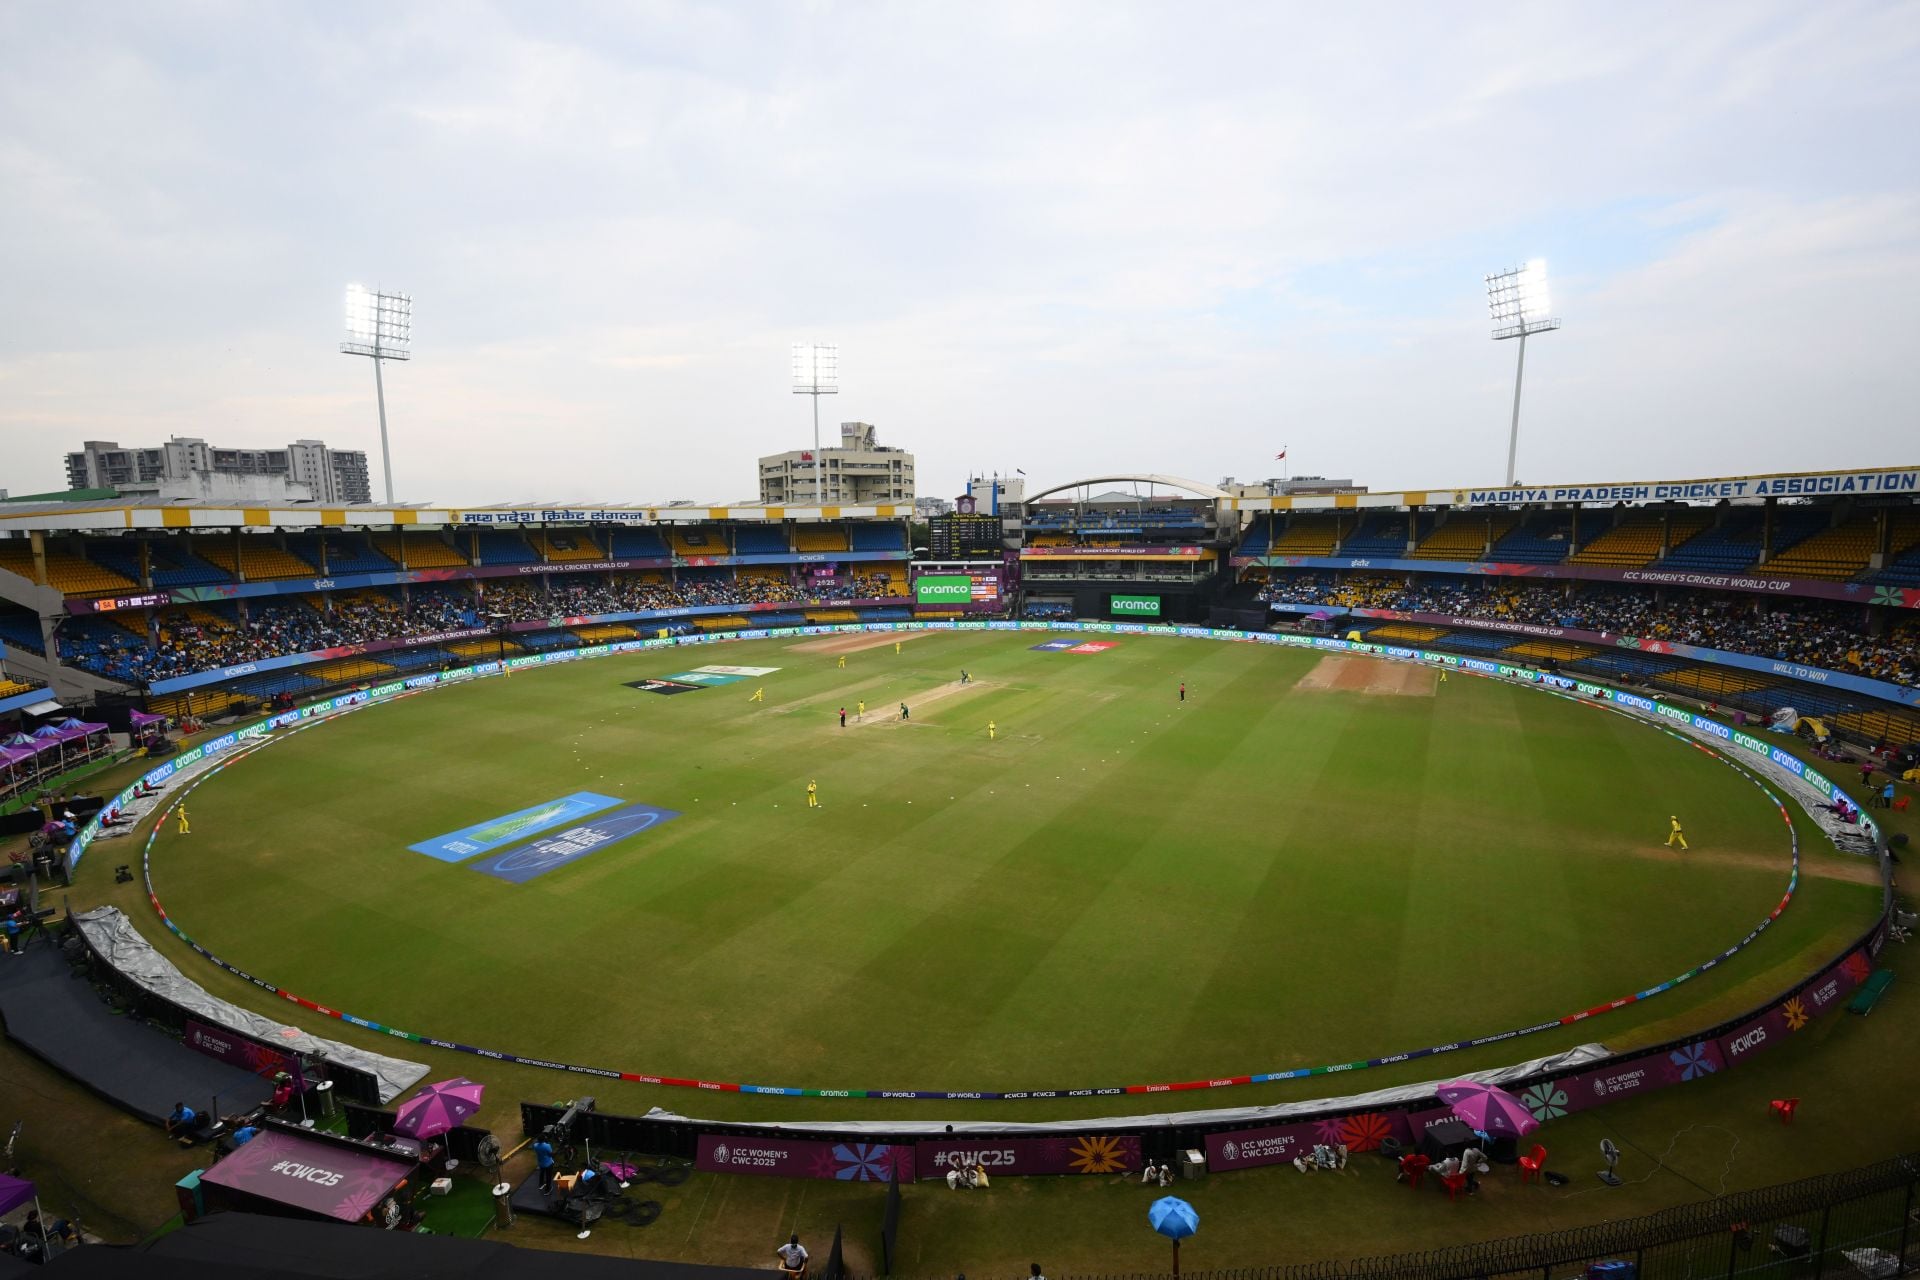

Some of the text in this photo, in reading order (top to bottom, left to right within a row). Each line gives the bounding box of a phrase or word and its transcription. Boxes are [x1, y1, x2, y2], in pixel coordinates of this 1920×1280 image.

[1471, 473, 1917, 503] MADHYA PRADESH CRICKET ASSOCIATION
[464, 510, 643, 523] मध्य प्रदेश क्रिकेट संगठन
[564, 563, 592, 571] CRICKET
[1623, 571, 1791, 591] ICC WOMEN'S CRICKET WORLD CUP
[920, 585, 968, 594] aramco
[1112, 599, 1158, 610] aramco
[927, 621, 955, 629] aramco
[958, 621, 985, 629] aramco
[989, 621, 1017, 629] aramco
[1020, 621, 1048, 629] aramco
[1051, 622, 1079, 630] aramco
[1083, 623, 1112, 631] aramco
[1115, 624, 1143, 632] aramco
[1147, 625, 1176, 634] aramco
[1465, 619, 1495, 628] WOMEN'S
[1495, 622, 1523, 632] CRICKET
[1523, 625, 1548, 635] WORLD
[1549, 628, 1564, 636] CUP
[1180, 627, 1209, 636] aramco
[1213, 629, 1243, 638] aramco
[405, 637, 416, 645] ICC
[417, 633, 447, 643] WOMEN'S
[446, 630, 470, 640] CRICKET
[644, 637, 673, 647] aramco
[1281, 635, 1312, 644] aramco
[1316, 638, 1346, 648] aramco
[579, 645, 608, 656] aramco
[612, 641, 640, 651] aramco
[511, 655, 541, 667] aramco
[545, 650, 575, 661] aramco
[442, 666, 472, 680] aramco
[1773, 663, 1829, 682] WILL TO WIN
[372, 682, 402, 697] aramco
[1617, 693, 1652, 710] aramco
[1657, 705, 1690, 723] aramco
[238, 722, 265, 740] aramco
[1695, 718, 1729, 738] aramco
[205, 735, 234, 754] aramco
[1734, 733, 1768, 755] aramco
[176, 748, 201, 769] aramco
[1773, 749, 1802, 774] aramco
[1804, 768, 1831, 794] aramco
[1730, 1026, 1767, 1056] #CWC25
[1389, 1054, 1409, 1063] WORLD
[1327, 1063, 1353, 1073] aramco
[639, 1075, 661, 1084] Emirates
[1267, 1071, 1295, 1081] aramco
[1605, 1069, 1645, 1087] ICC WOMEN'S
[698, 1081, 721, 1090] Emirates
[1146, 1084, 1170, 1092] Emirates
[1209, 1078, 1233, 1087] Emirates
[1608, 1078, 1640, 1093] CWC 2025
[757, 1087, 785, 1095] aramco
[820, 1089, 849, 1097] aramco
[892, 1091, 916, 1099] WORLD
[1097, 1087, 1120, 1095] #CWC25
[1241, 1135, 1295, 1151] ICC WOMEN'S
[733, 1148, 788, 1159] ICC WOMEN'S
[1242, 1145, 1286, 1158] CWC 2025
[731, 1156, 776, 1167] CWC 2025
[934, 1149, 1016, 1167] #CWC25
[270, 1160, 344, 1187] #CWC25
